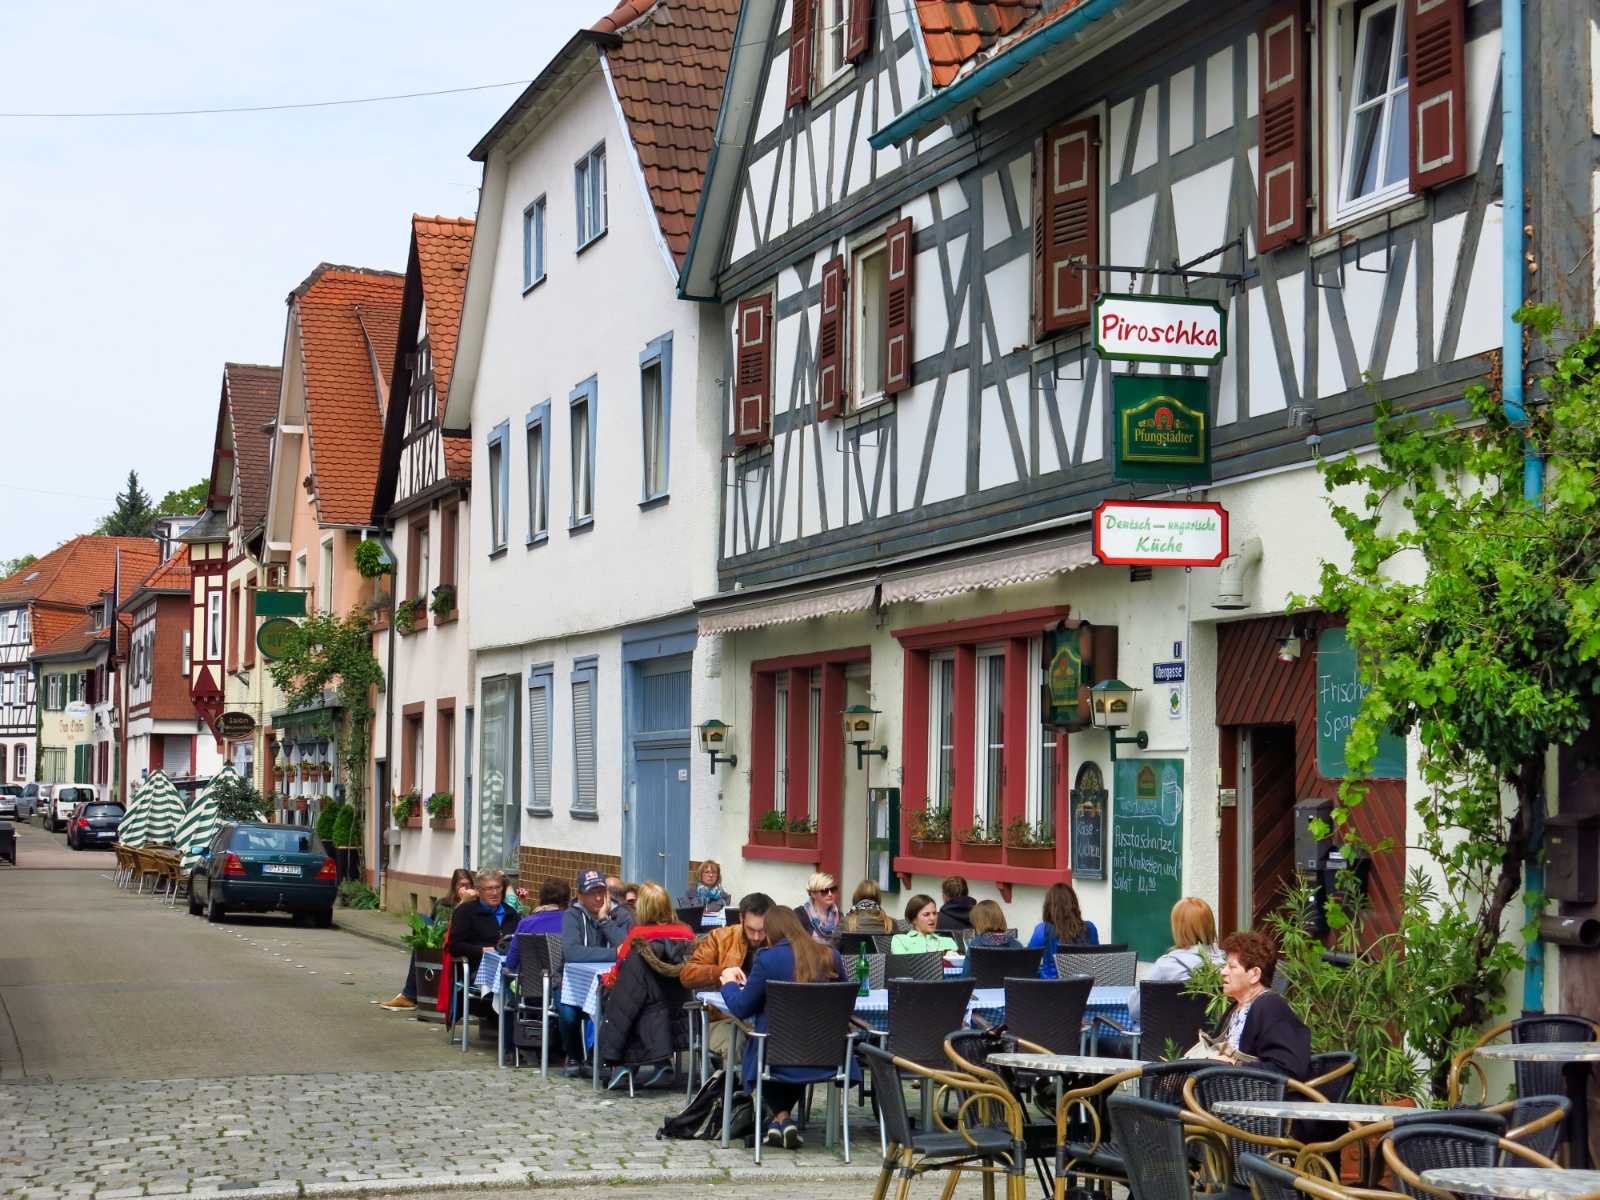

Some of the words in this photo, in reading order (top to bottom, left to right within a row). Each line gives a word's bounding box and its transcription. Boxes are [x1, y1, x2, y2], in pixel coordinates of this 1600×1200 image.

[1102, 313, 1218, 346] Piroschka
[1134, 428, 1194, 446] Pfungstädter
[1135, 536, 1184, 553] Küche
[1154, 665, 1183, 681] Obergasse
[1114, 825, 1179, 854] Pusztaschnitzel
[1113, 848, 1127, 869] mit
[1163, 856, 1179, 881] und
[1113, 870, 1134, 893] Salat
